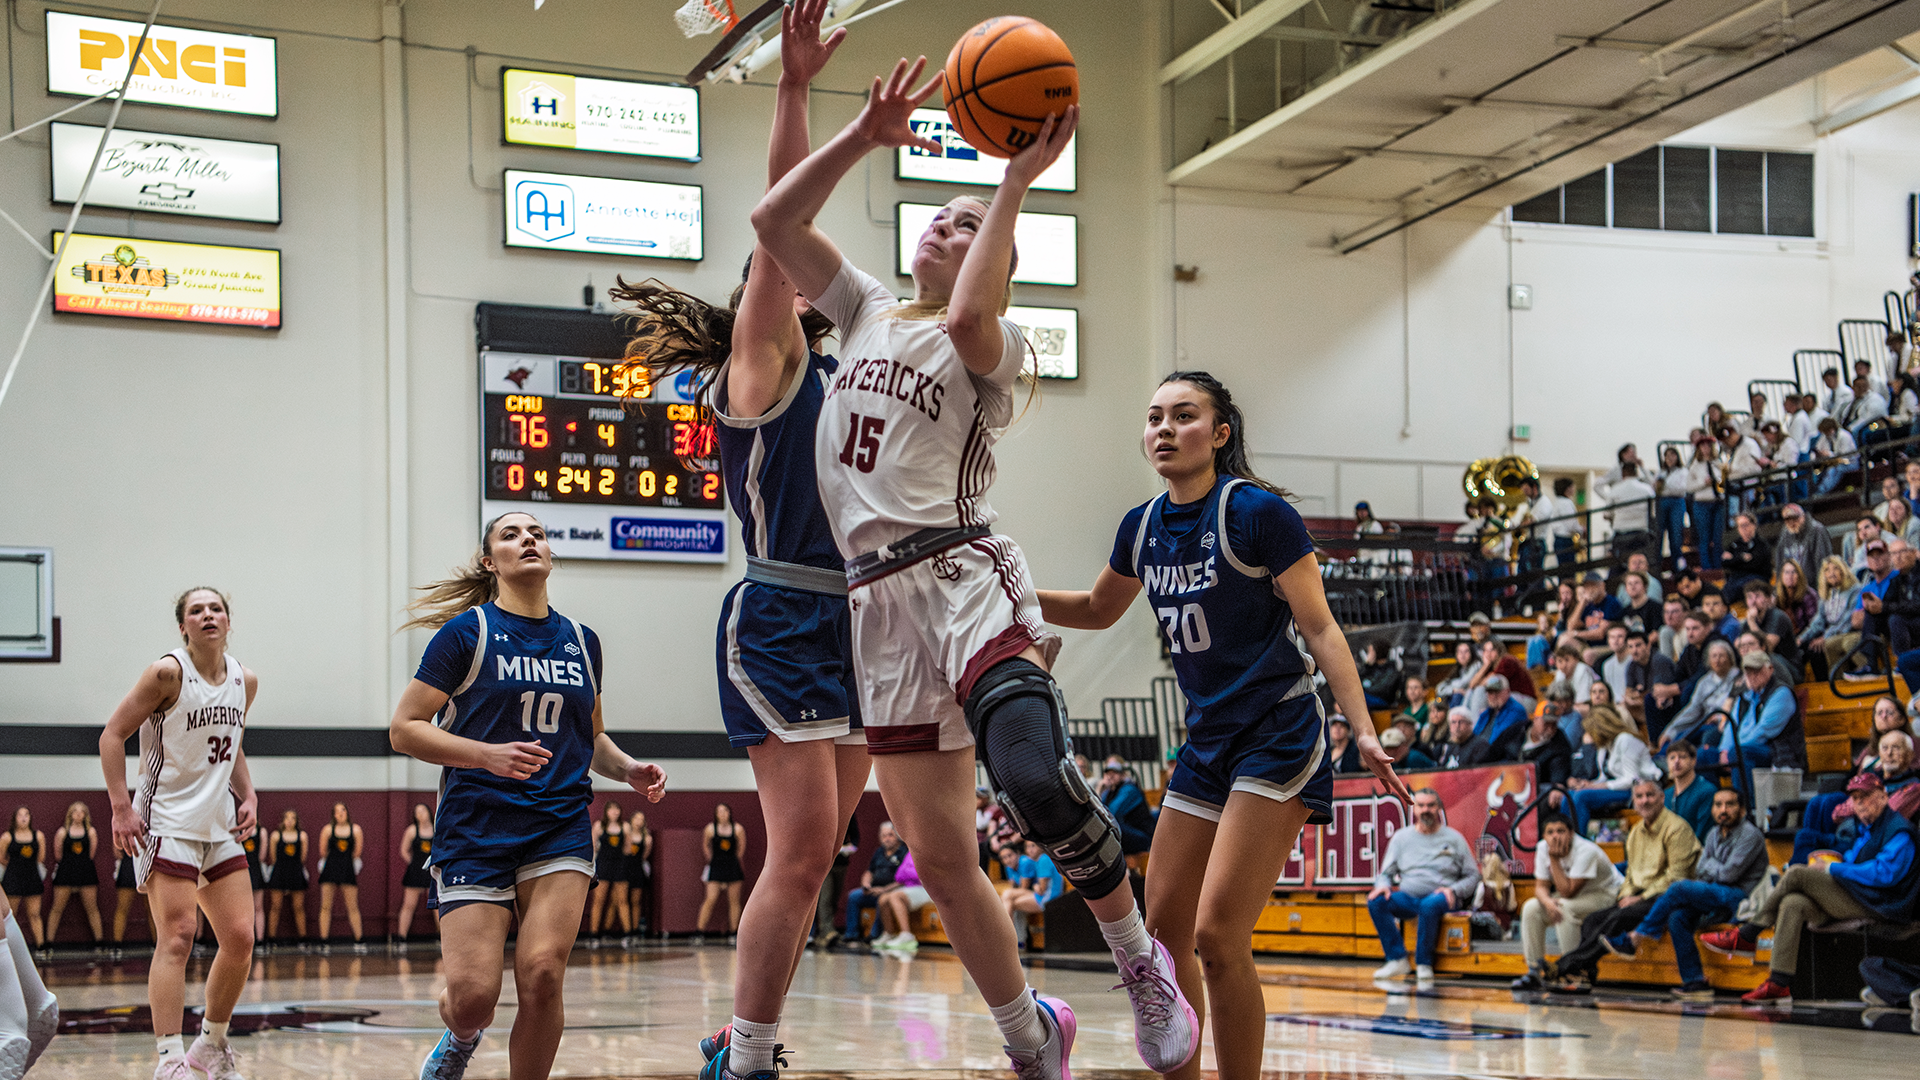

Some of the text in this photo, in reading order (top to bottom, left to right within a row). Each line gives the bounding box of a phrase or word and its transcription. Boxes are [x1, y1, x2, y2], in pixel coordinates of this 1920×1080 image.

[586, 103, 686, 125] 970-242-4429
[174, 156, 233, 182] Miller
[585, 202, 659, 220] Annette
[86, 263, 166, 288] TEXAS
[210, 269, 240, 279] North
[67, 295, 95, 308] Call
[97, 297, 137, 312] Ahead
[505, 395, 542, 413] CMU
[588, 407, 625, 422] PERIOD
[509, 414, 548, 448] 76
[597, 424, 615, 447] 4
[839, 412, 886, 474] 15
[491, 449, 524, 462] FOULS
[593, 454, 620, 467] FOUL
[507, 464, 524, 491] 0
[534, 470, 548, 488] 4
[557, 466, 591, 494] 24
[598, 468, 615, 495] 2
[639, 470, 656, 497] 0
[664, 474, 678, 495] 2
[702, 473, 719, 499] 2
[570, 528, 604, 541] Bank
[615, 520, 719, 546] Community
[1144, 555, 1219, 596] MINES
[1157, 602, 1212, 654] 20
[496, 654, 584, 687] MINES
[520, 690, 564, 734] 10
[207, 735, 232, 765] 32
